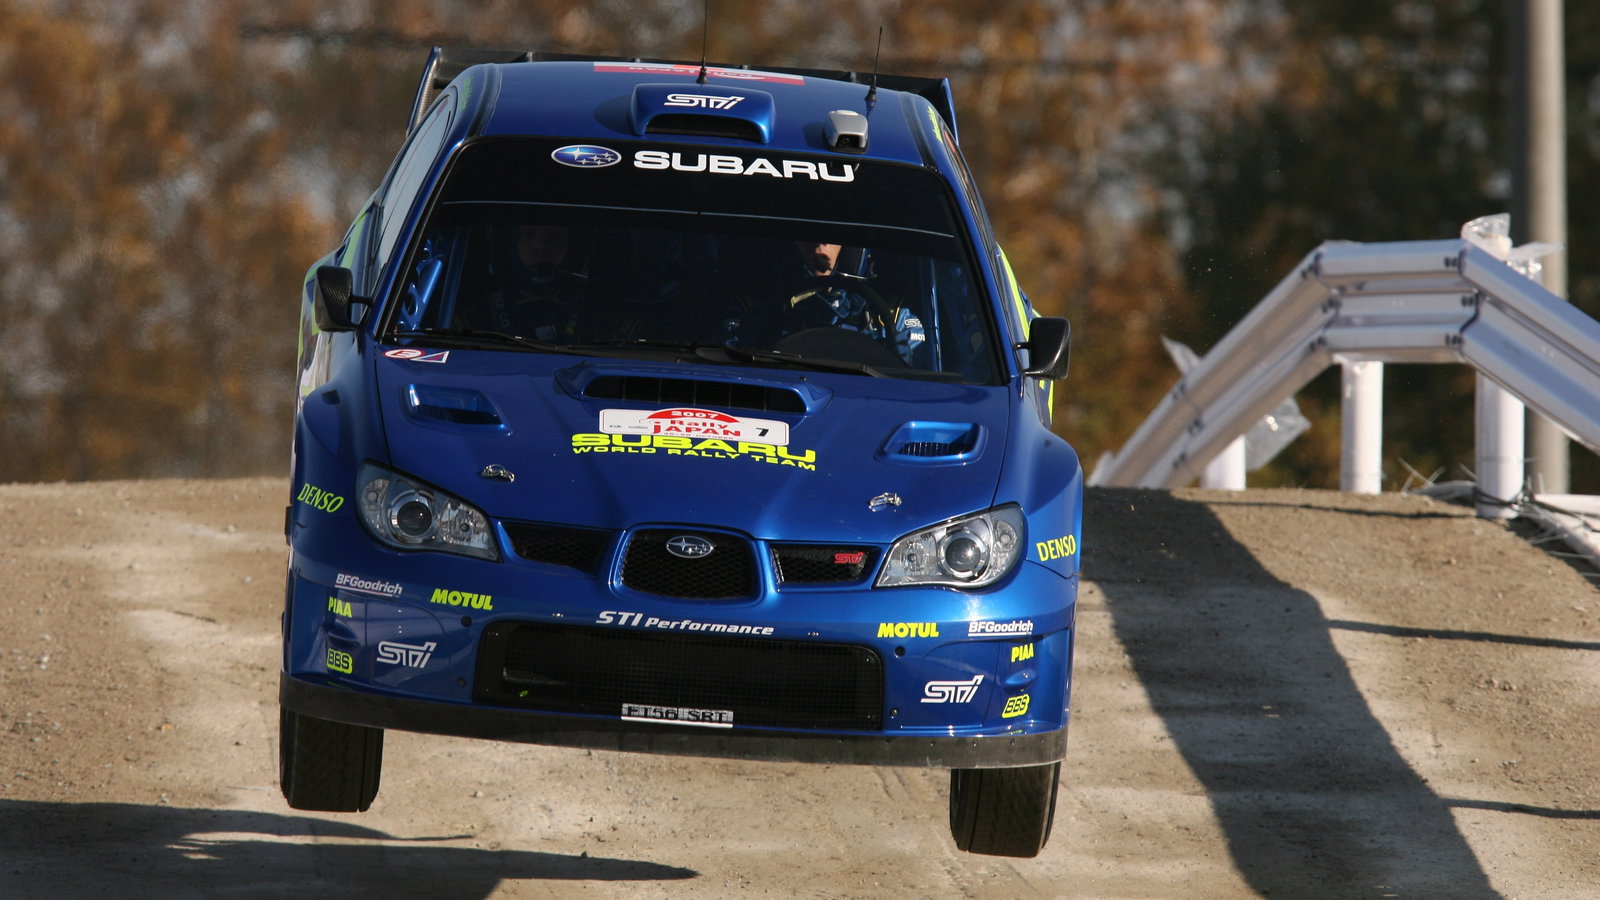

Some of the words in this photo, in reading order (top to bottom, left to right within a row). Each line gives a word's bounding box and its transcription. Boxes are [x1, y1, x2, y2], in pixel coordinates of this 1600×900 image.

[633, 150, 855, 183] SUBARU
[670, 420, 729, 429] Rally
[671, 410, 719, 419] 2007
[755, 427, 770, 437] 7
[571, 433, 816, 463] SUBARU
[572, 446, 657, 454] WORLD
[667, 449, 741, 459] RALLY
[751, 455, 816, 471] TEAM
[297, 483, 344, 513] DENSO
[1036, 535, 1076, 562] DENSO
[335, 573, 403, 596] BFGoodrich
[328, 597, 353, 618] PIAA
[430, 588, 493, 611] MOTUL
[595, 610, 644, 627] STI
[645, 617, 775, 636] Performance
[877, 622, 939, 638] MOTUL
[968, 620, 1033, 634] BFGoodrich
[327, 651, 351, 671] BBS
[1011, 643, 1035, 662] PIAA
[1005, 695, 1029, 715] BBS
[687, 709, 728, 722] SRT
